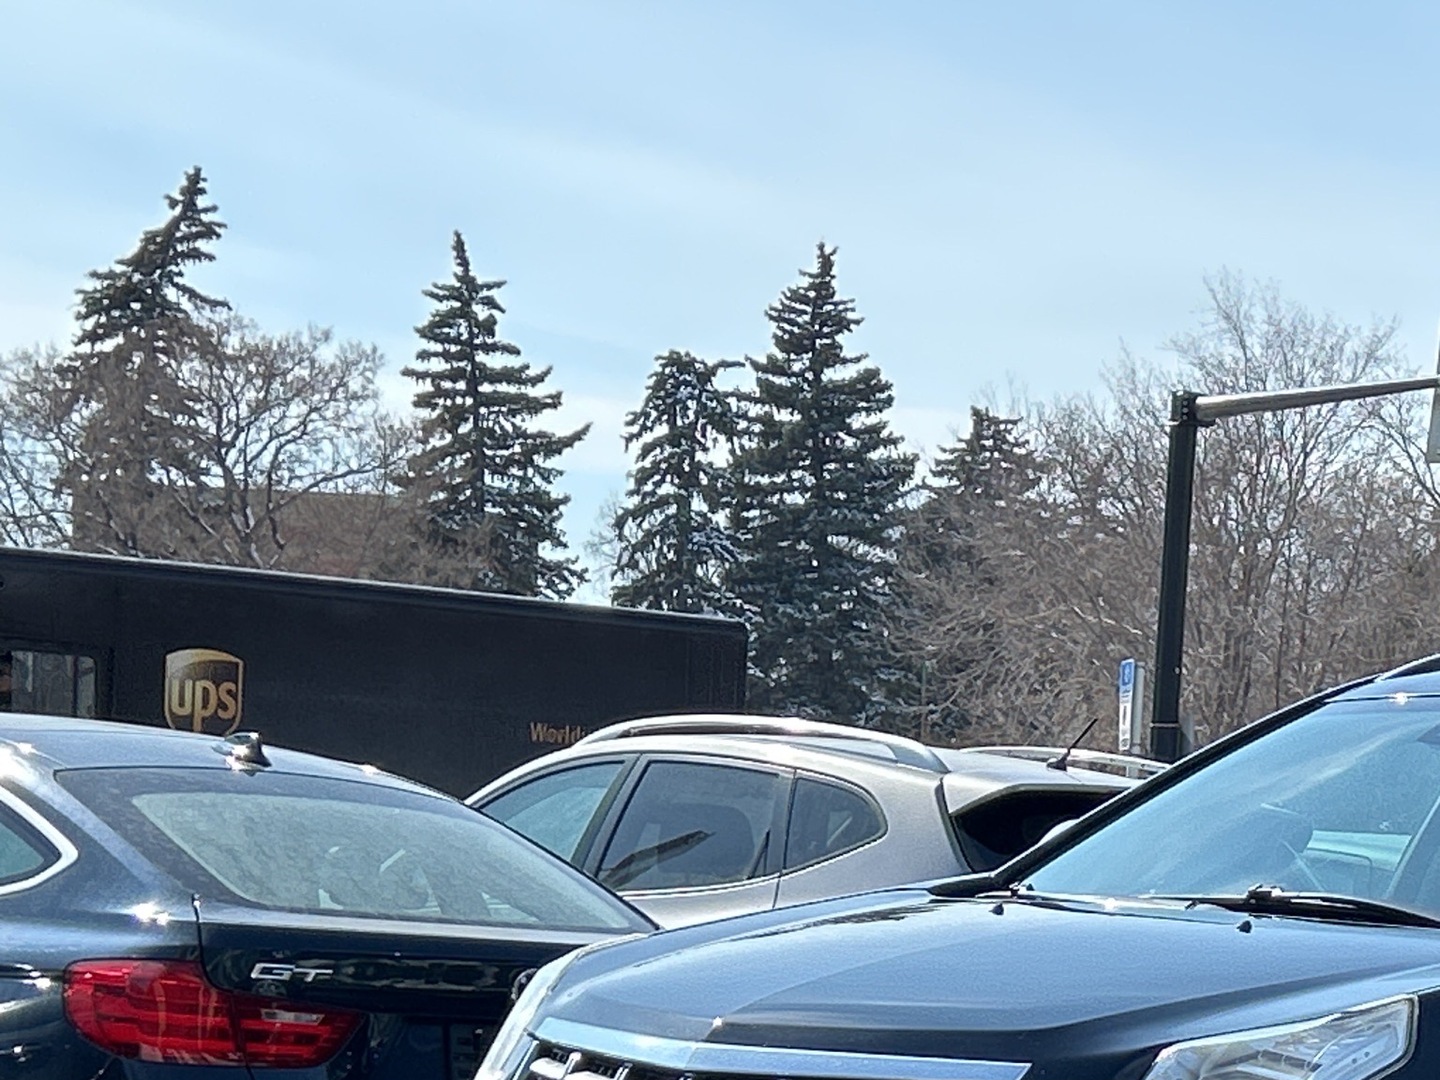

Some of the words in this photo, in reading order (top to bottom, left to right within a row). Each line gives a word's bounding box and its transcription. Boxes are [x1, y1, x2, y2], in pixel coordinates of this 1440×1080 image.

[171, 679, 237, 732] ups
[529, 722, 586, 744] World
[250, 963, 333, 982] GT
